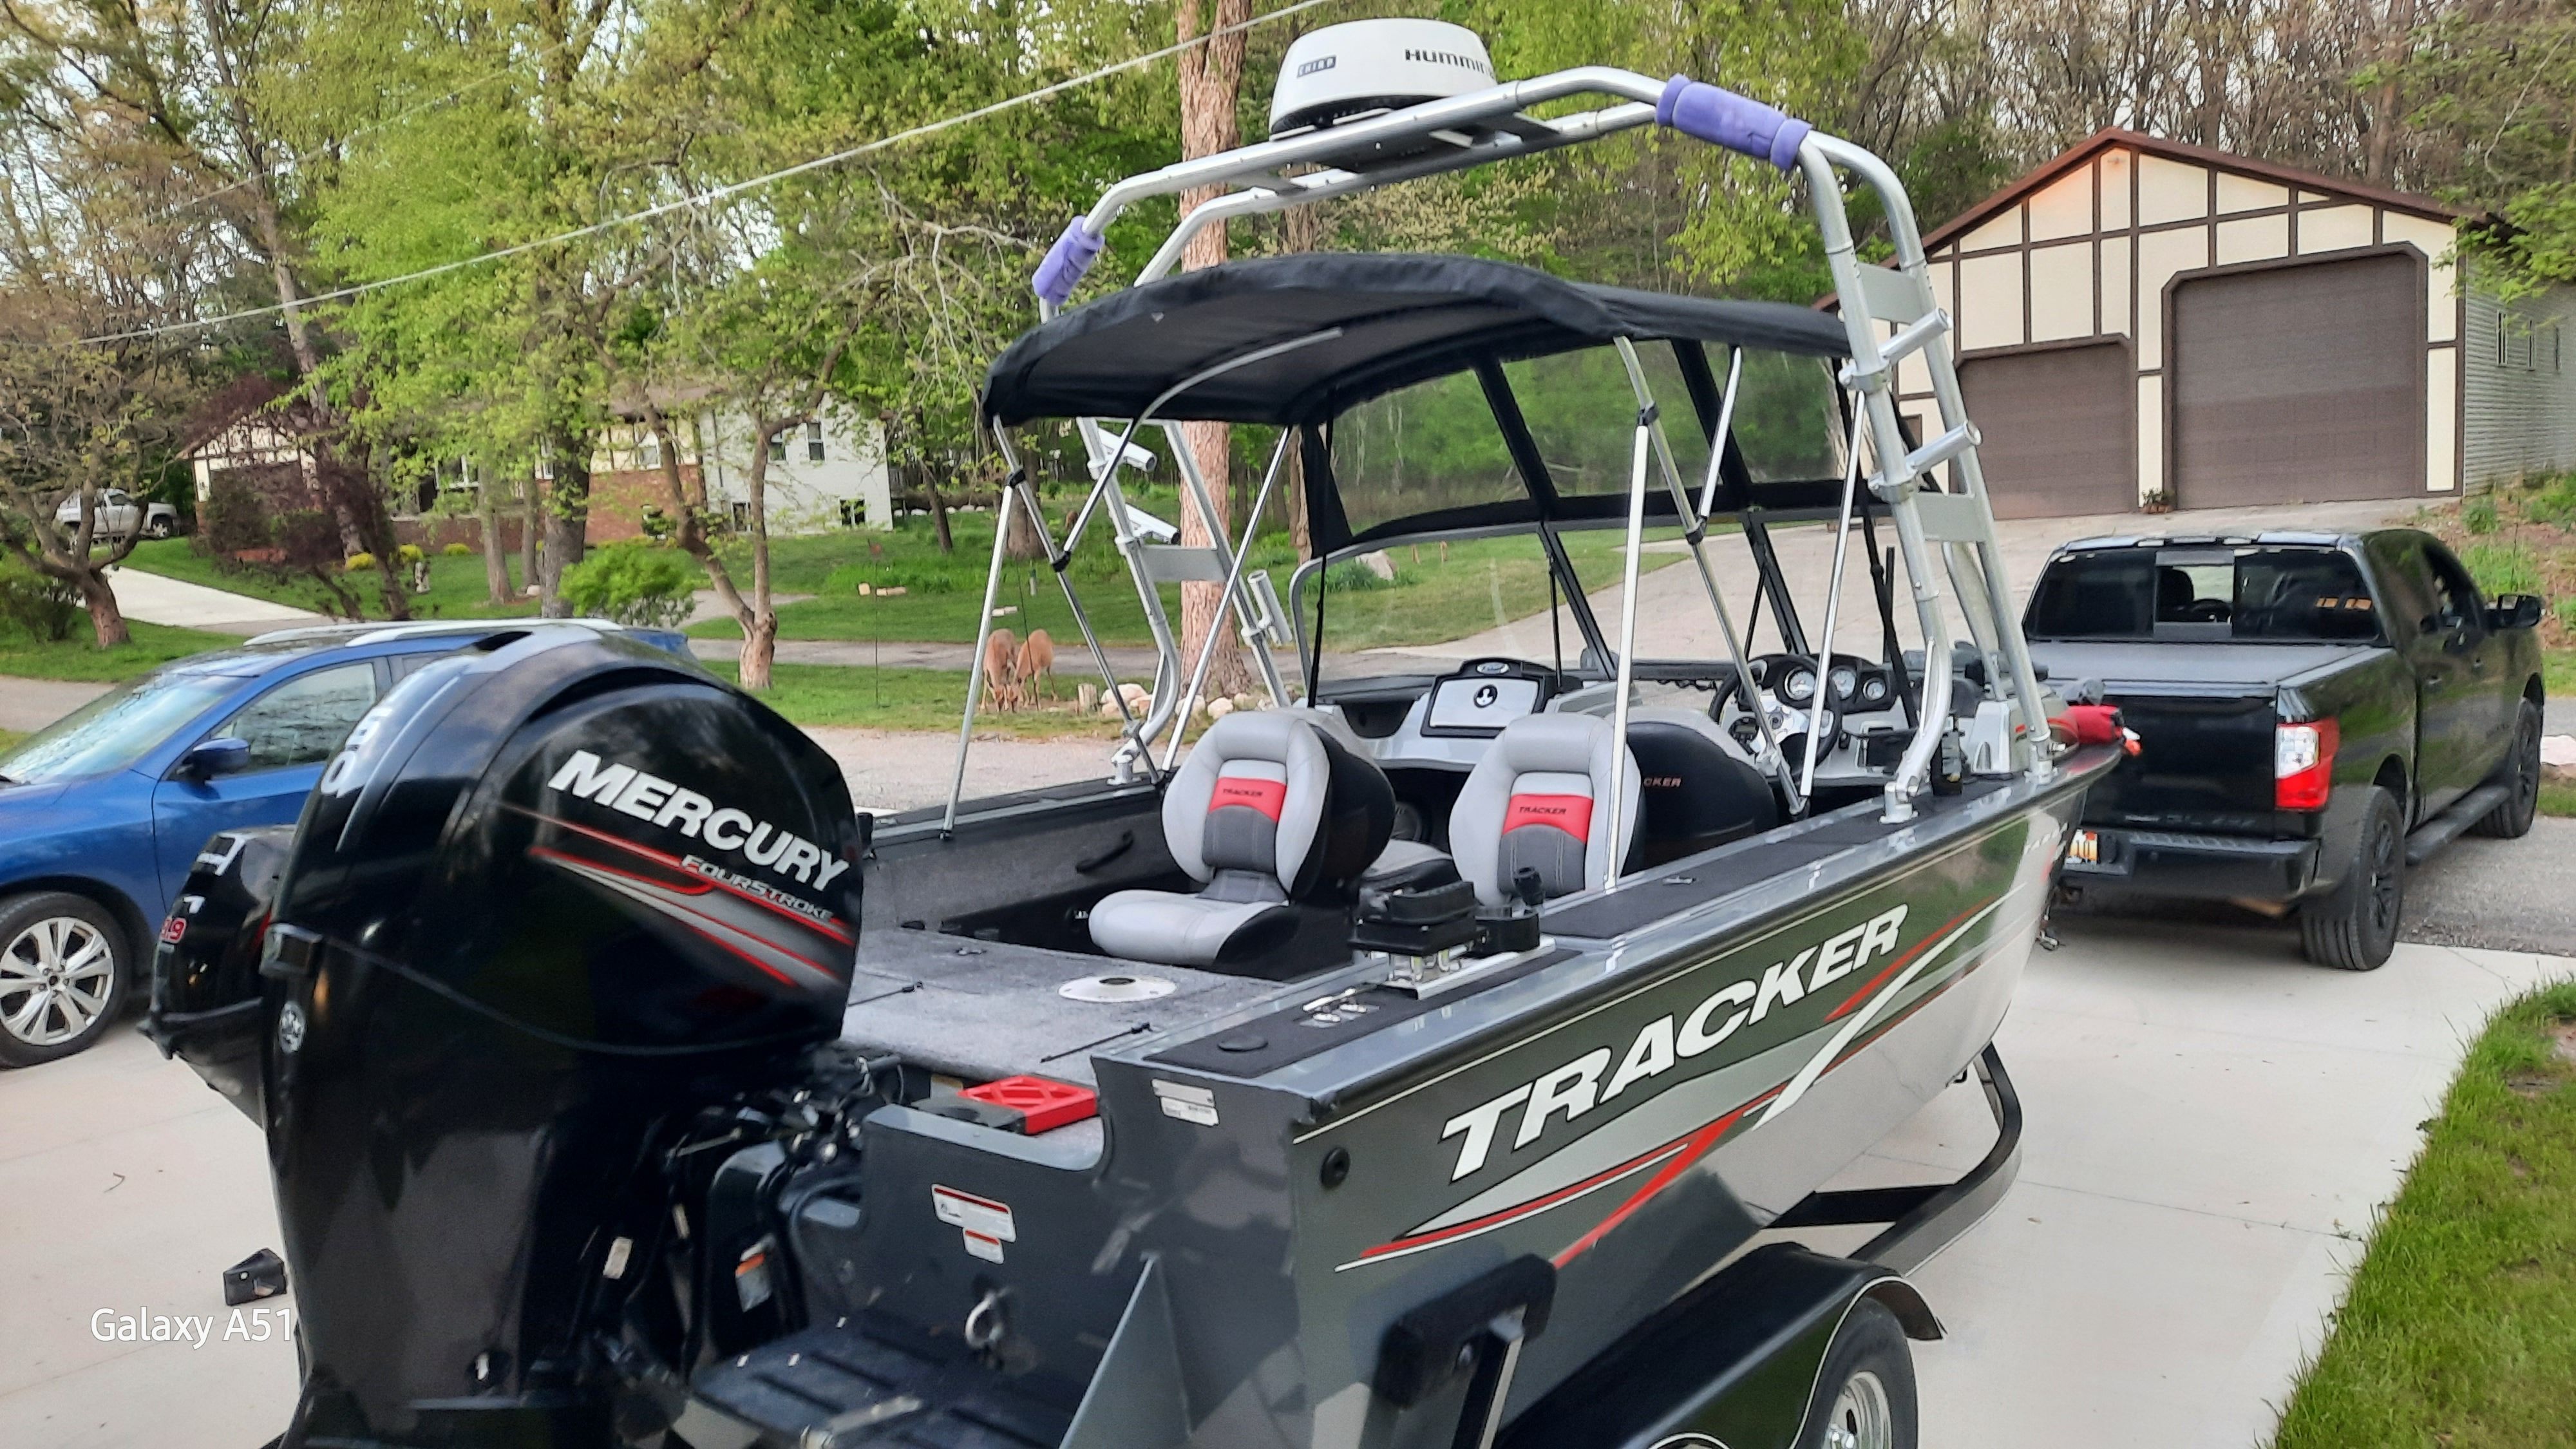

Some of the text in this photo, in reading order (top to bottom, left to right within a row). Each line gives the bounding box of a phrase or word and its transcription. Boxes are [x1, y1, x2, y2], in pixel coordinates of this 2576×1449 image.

[547, 750, 849, 892] MERCURY
[681, 855, 833, 922] FOURSTROKE
[1440, 904, 1908, 1184] TRACKER
